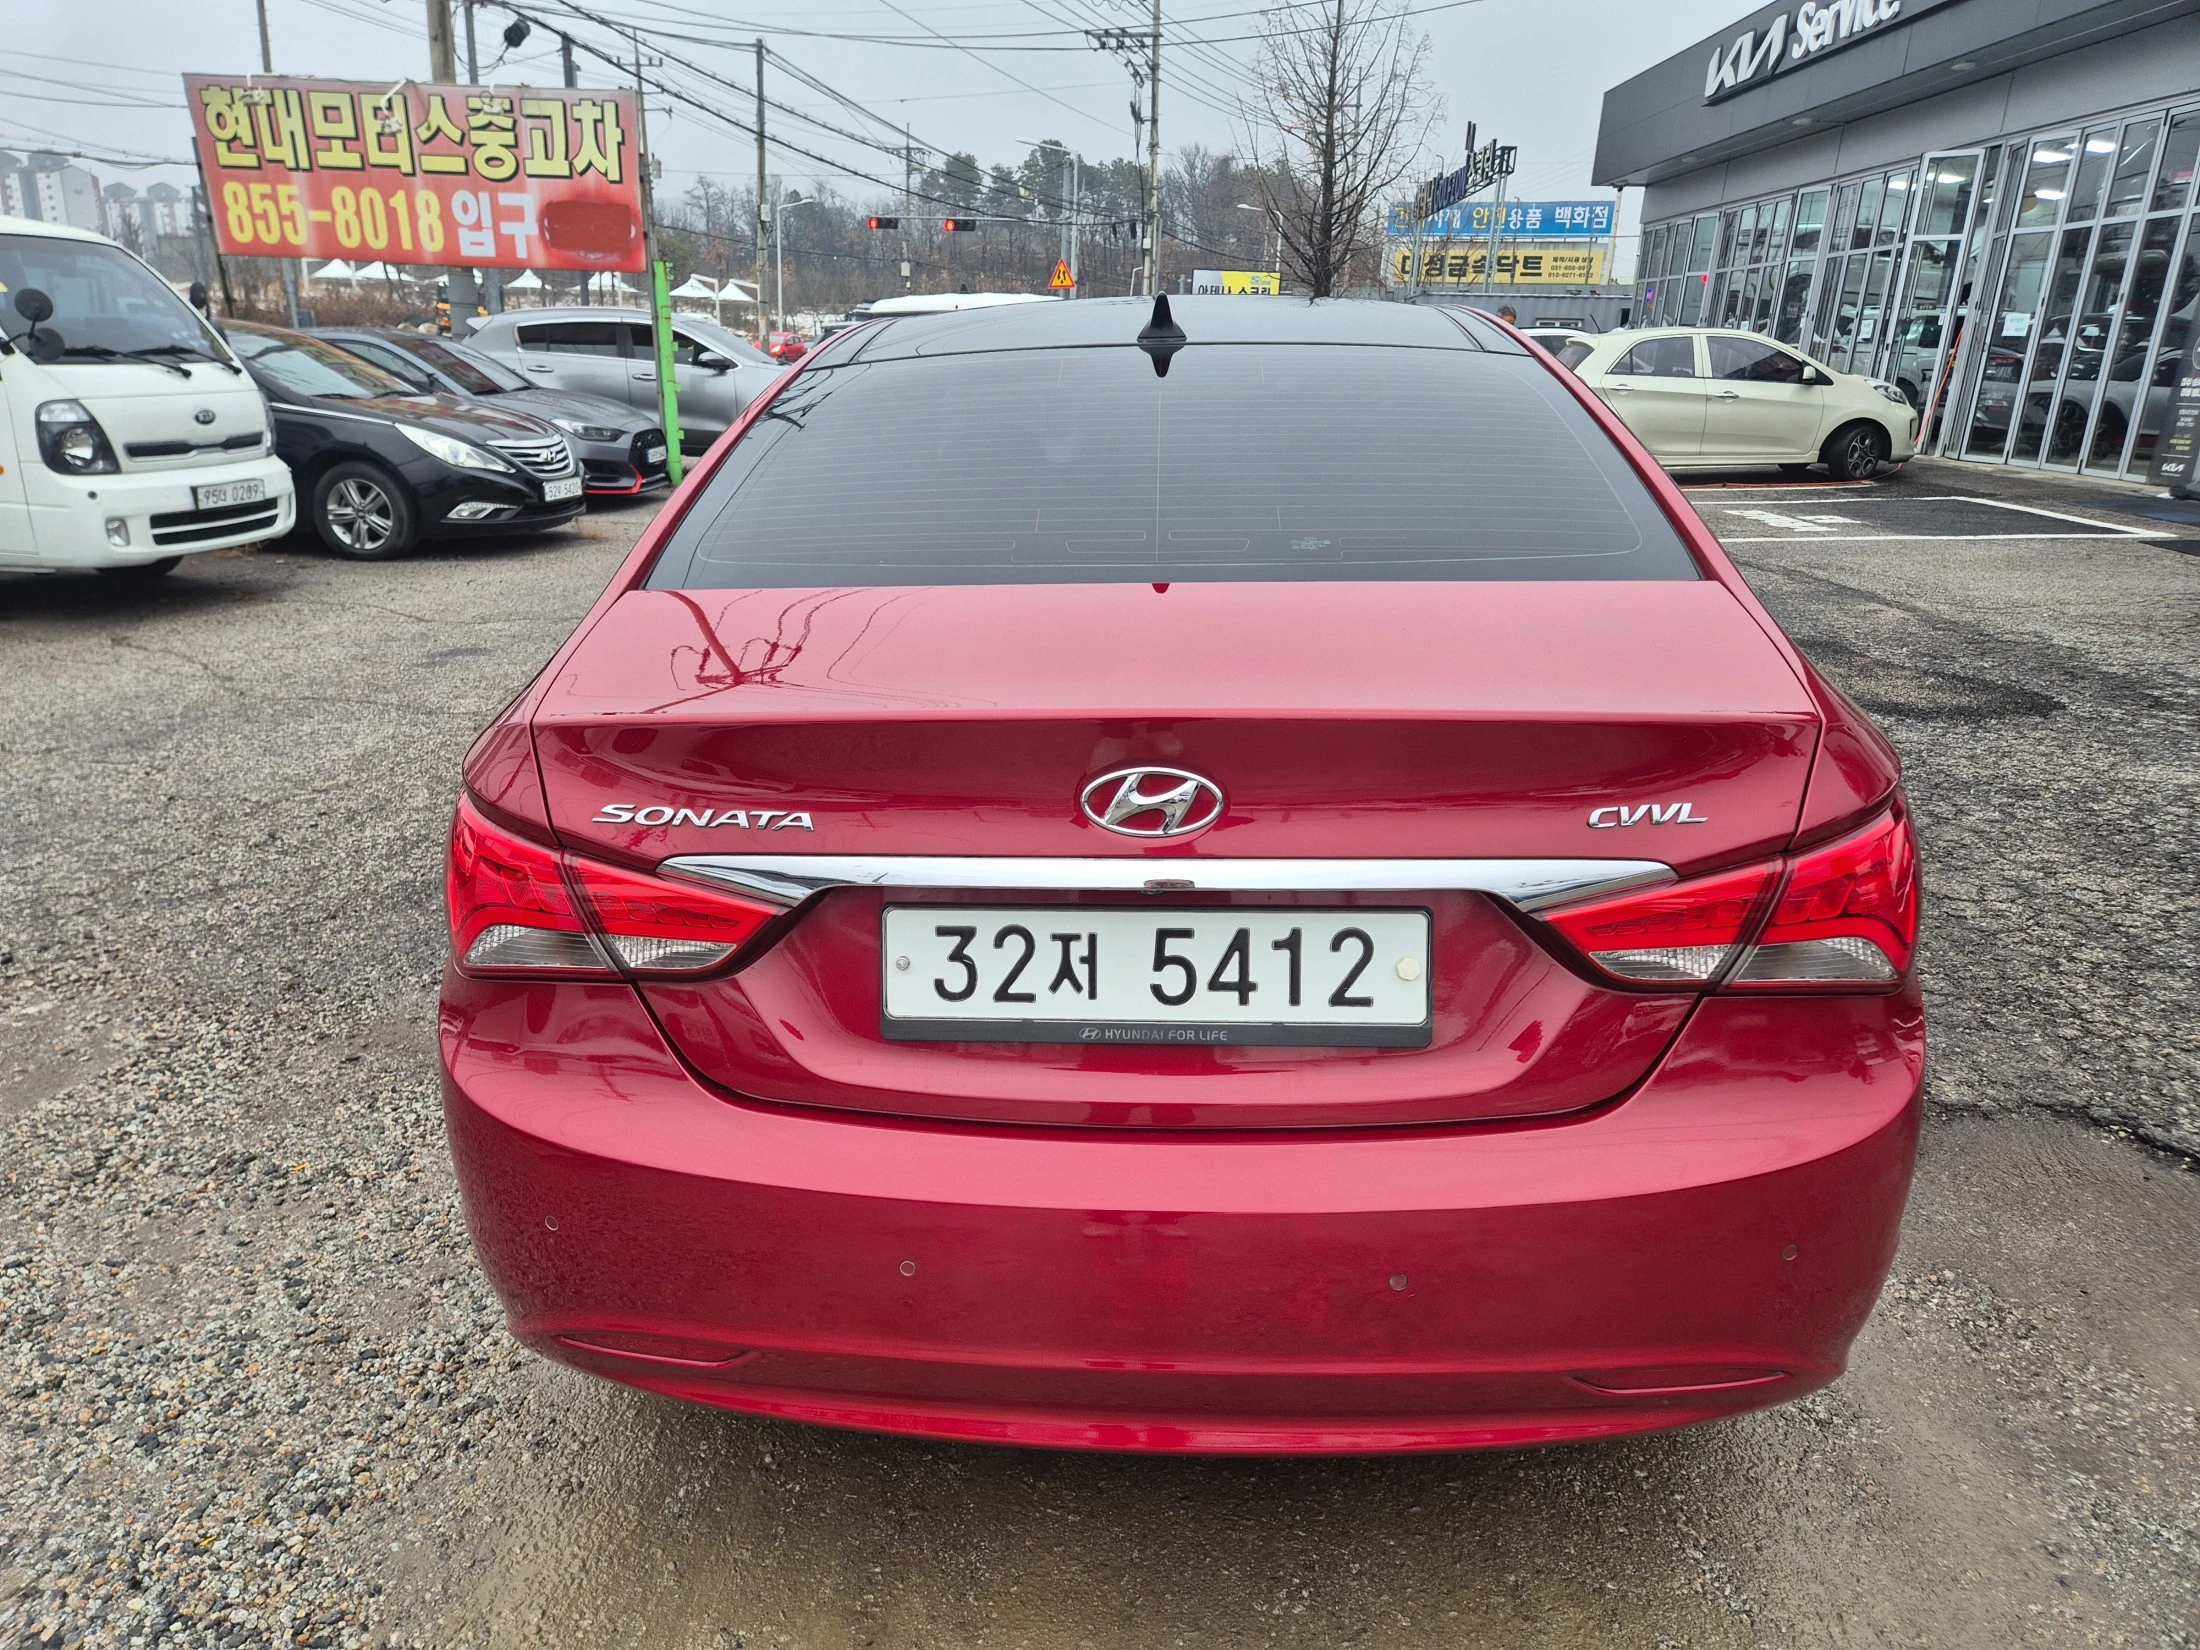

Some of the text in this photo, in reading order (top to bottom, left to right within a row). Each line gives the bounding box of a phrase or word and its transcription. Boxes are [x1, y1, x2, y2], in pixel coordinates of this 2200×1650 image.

[223, 181, 538, 259] 855-8018 입구
[1554, 205, 1609, 229] 백화점
[591, 804, 815, 832] SONATA
[1587, 802, 1708, 828] CVVL
[933, 924, 1375, 1008] 32저 5412
[1105, 1028, 1228, 1041] HYUNDAI FOR LIFE
